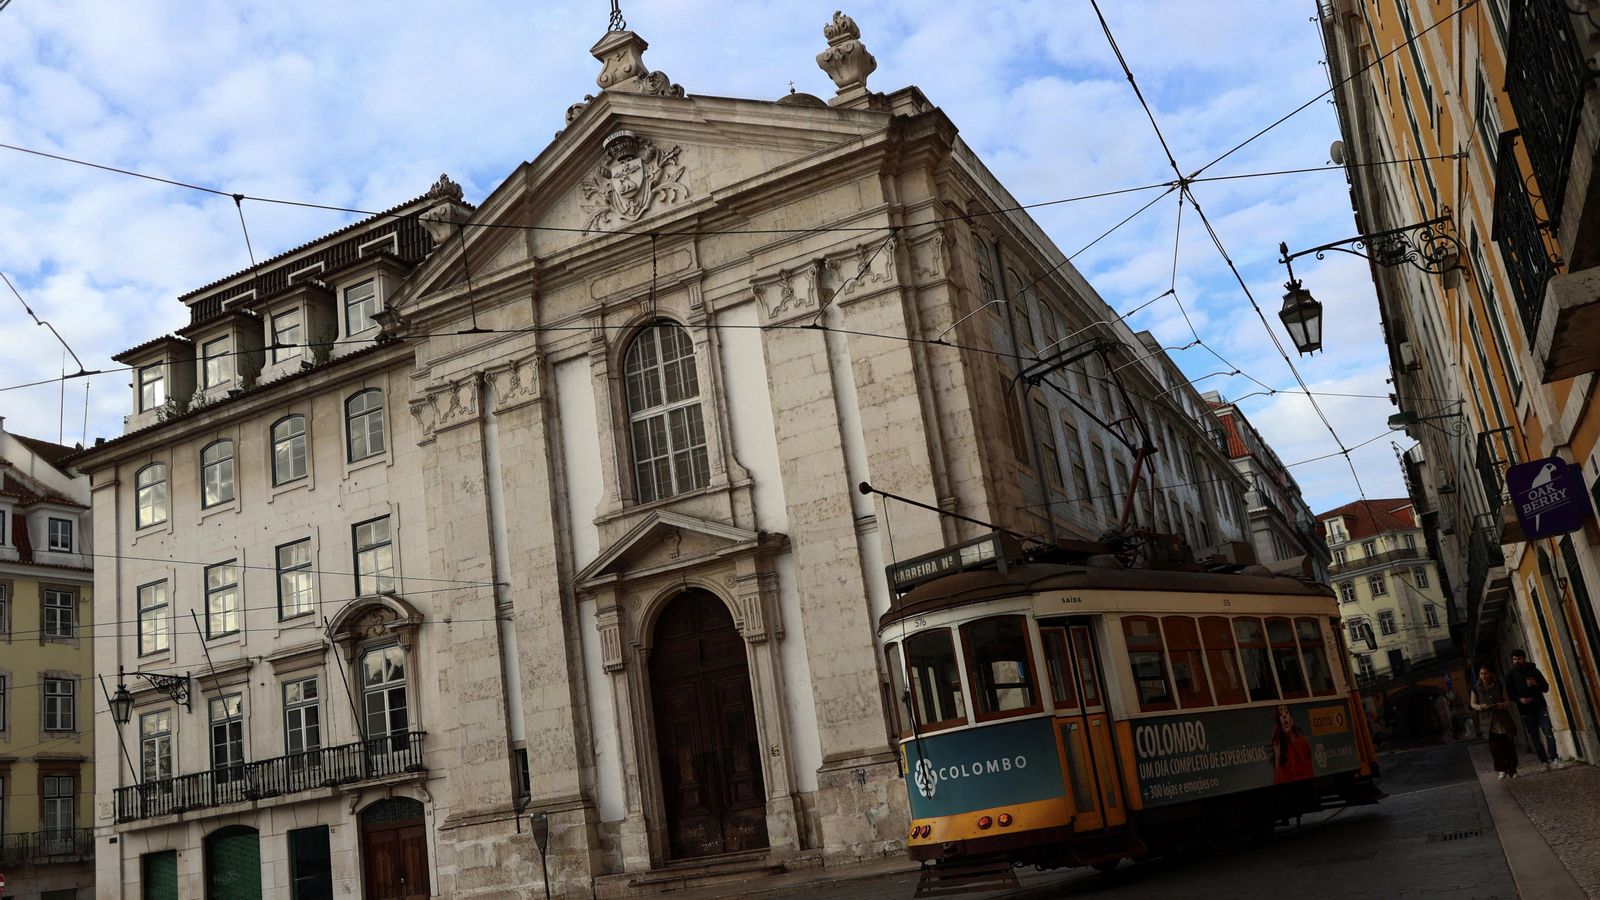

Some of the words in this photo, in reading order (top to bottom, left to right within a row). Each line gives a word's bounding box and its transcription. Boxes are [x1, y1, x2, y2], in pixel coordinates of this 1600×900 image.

[1522, 488, 1567, 514] BERRY
[1528, 482, 1556, 500] OAK
[894, 561, 938, 583] CARREIRA
[914, 619, 927, 628] 576
[1136, 720, 1210, 758] COLOMBO,
[939, 755, 1027, 781] COLOMBO
[1140, 761, 1154, 779] UM
[1154, 758, 1170, 777] DIA
[1169, 752, 1209, 775] COMPLETO
[1208, 751, 1220, 769] DE
